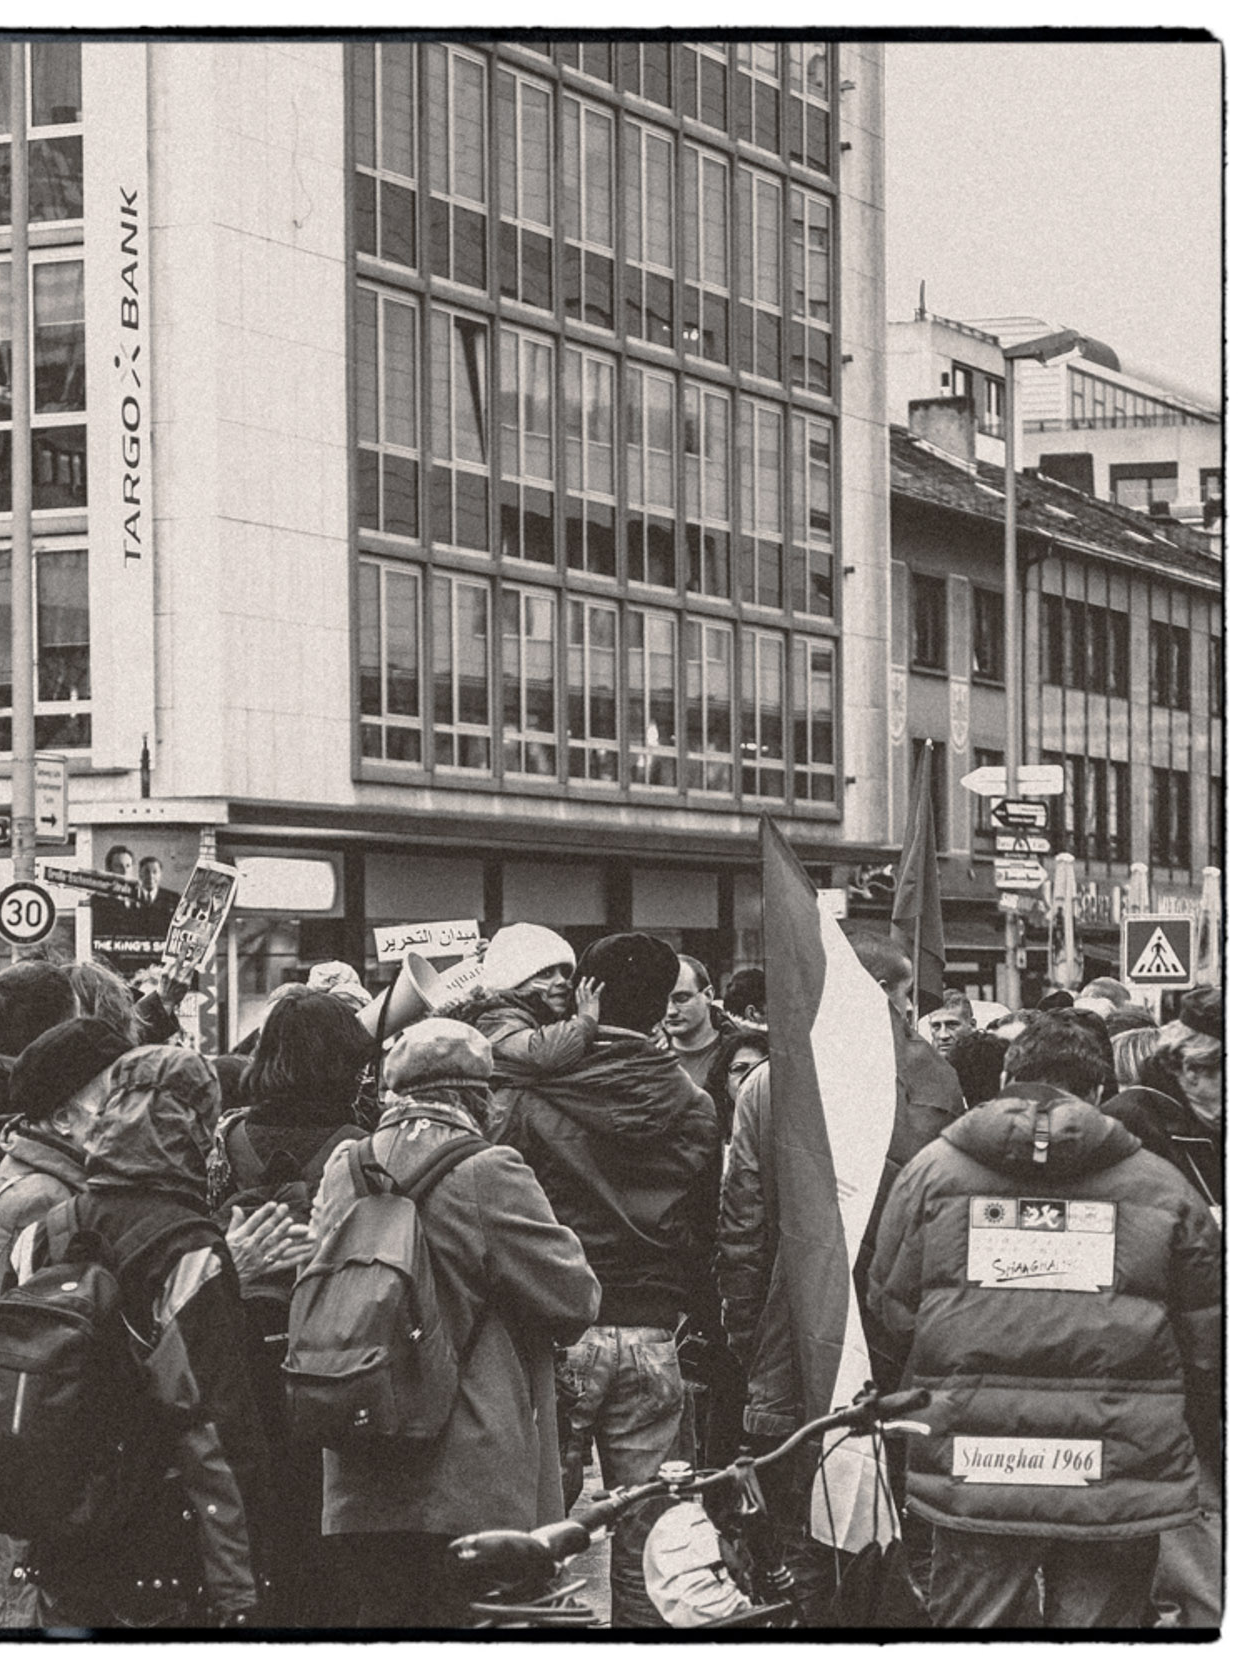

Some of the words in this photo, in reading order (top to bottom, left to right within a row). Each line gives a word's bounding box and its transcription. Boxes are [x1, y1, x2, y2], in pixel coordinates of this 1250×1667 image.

[120, 185, 140, 331] BANK
[122, 395, 142, 569] TARGO
[7, 899, 42, 928] 30
[93, 940, 113, 952] THE
[114, 940, 151, 953] KING'S
[380, 929, 432, 953] التحرير
[439, 928, 478, 947] ميدان
[963, 1447, 1047, 1474] Shanghai
[1052, 1448, 1095, 1472] 1966
